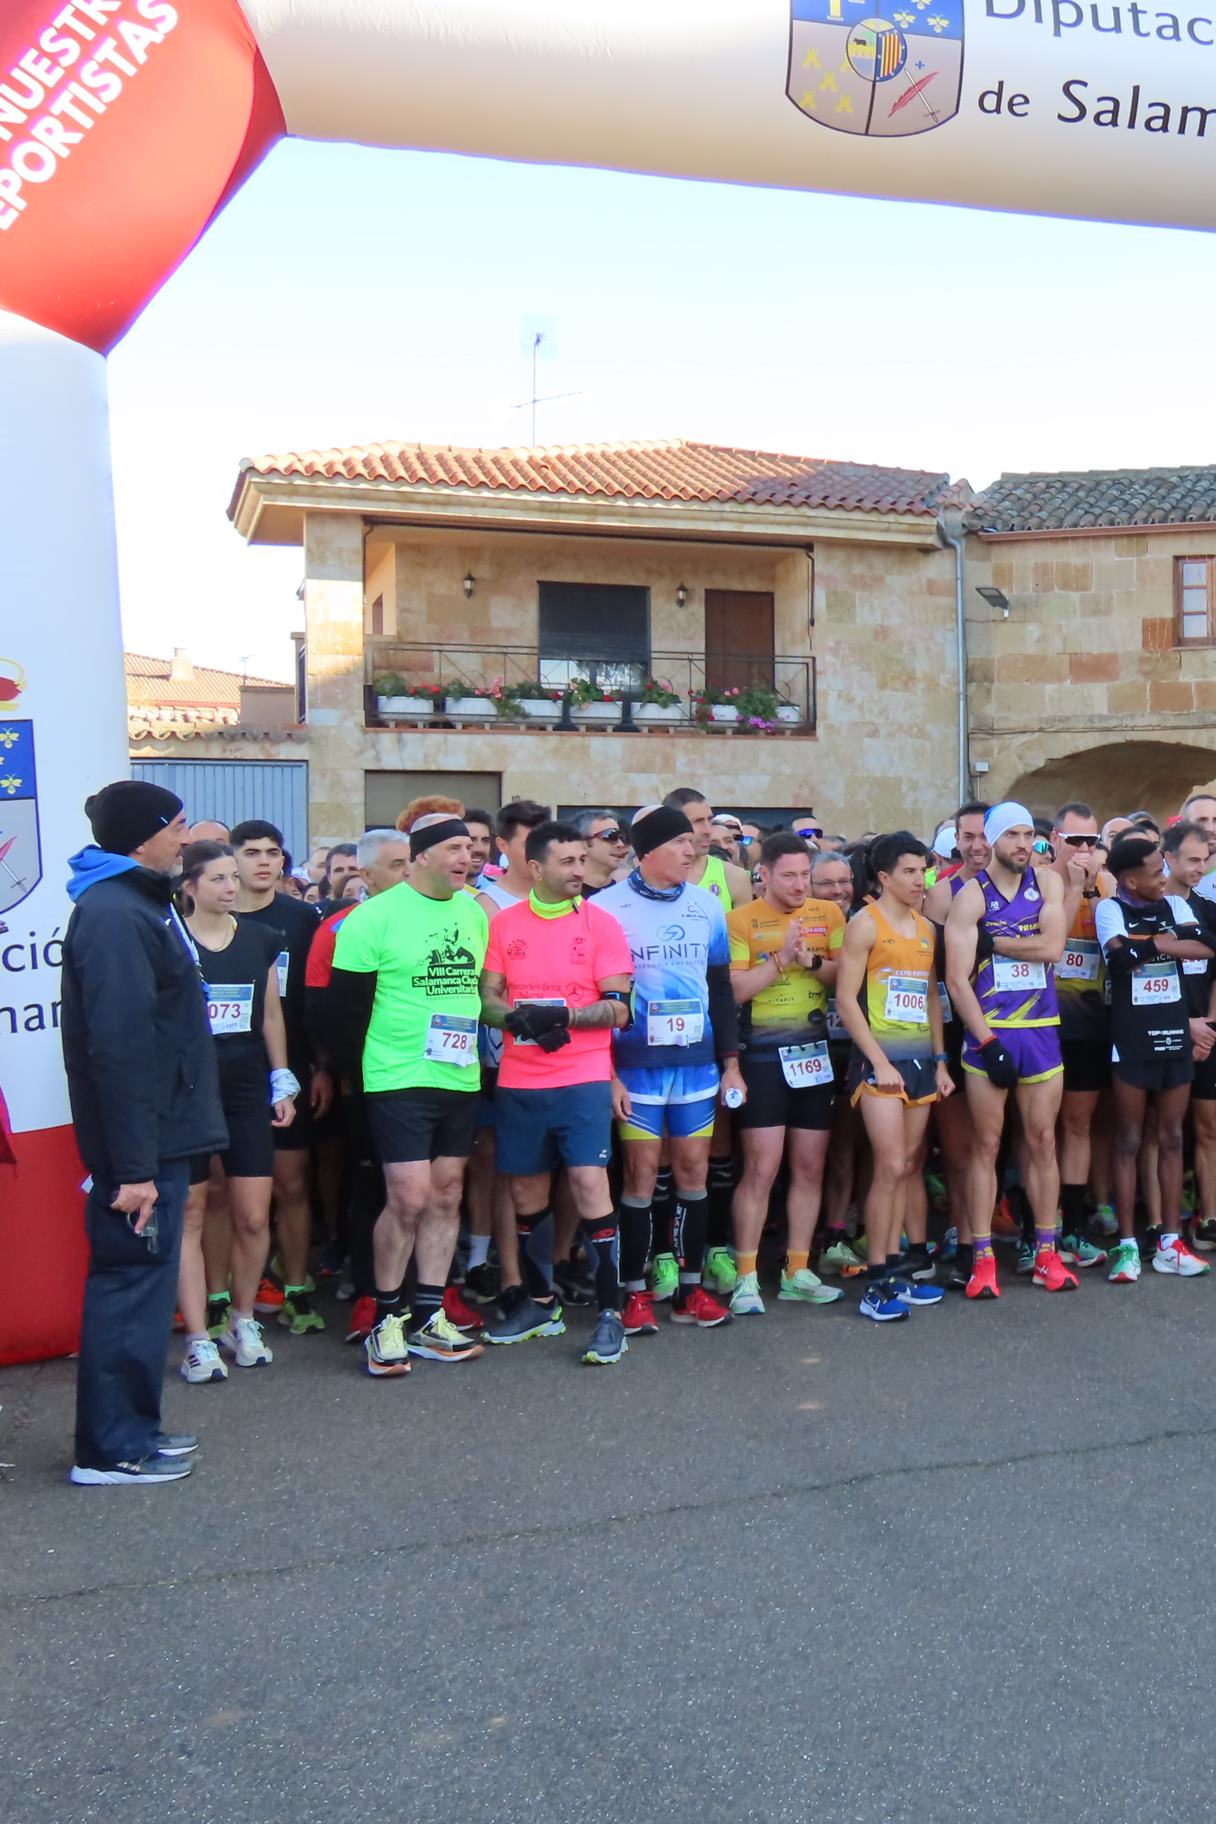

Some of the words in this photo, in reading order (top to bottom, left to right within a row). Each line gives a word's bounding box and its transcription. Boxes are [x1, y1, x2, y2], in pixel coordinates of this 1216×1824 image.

[978, 80, 1031, 117] de
[1066, 953, 1084, 967] 80
[1011, 963, 1030, 978] 38
[1144, 978, 1169, 993] 459
[894, 993, 925, 1010] 1006
[666, 1017, 685, 1032] 19
[442, 1032, 468, 1050] 728
[789, 1058, 822, 1077] 1169
